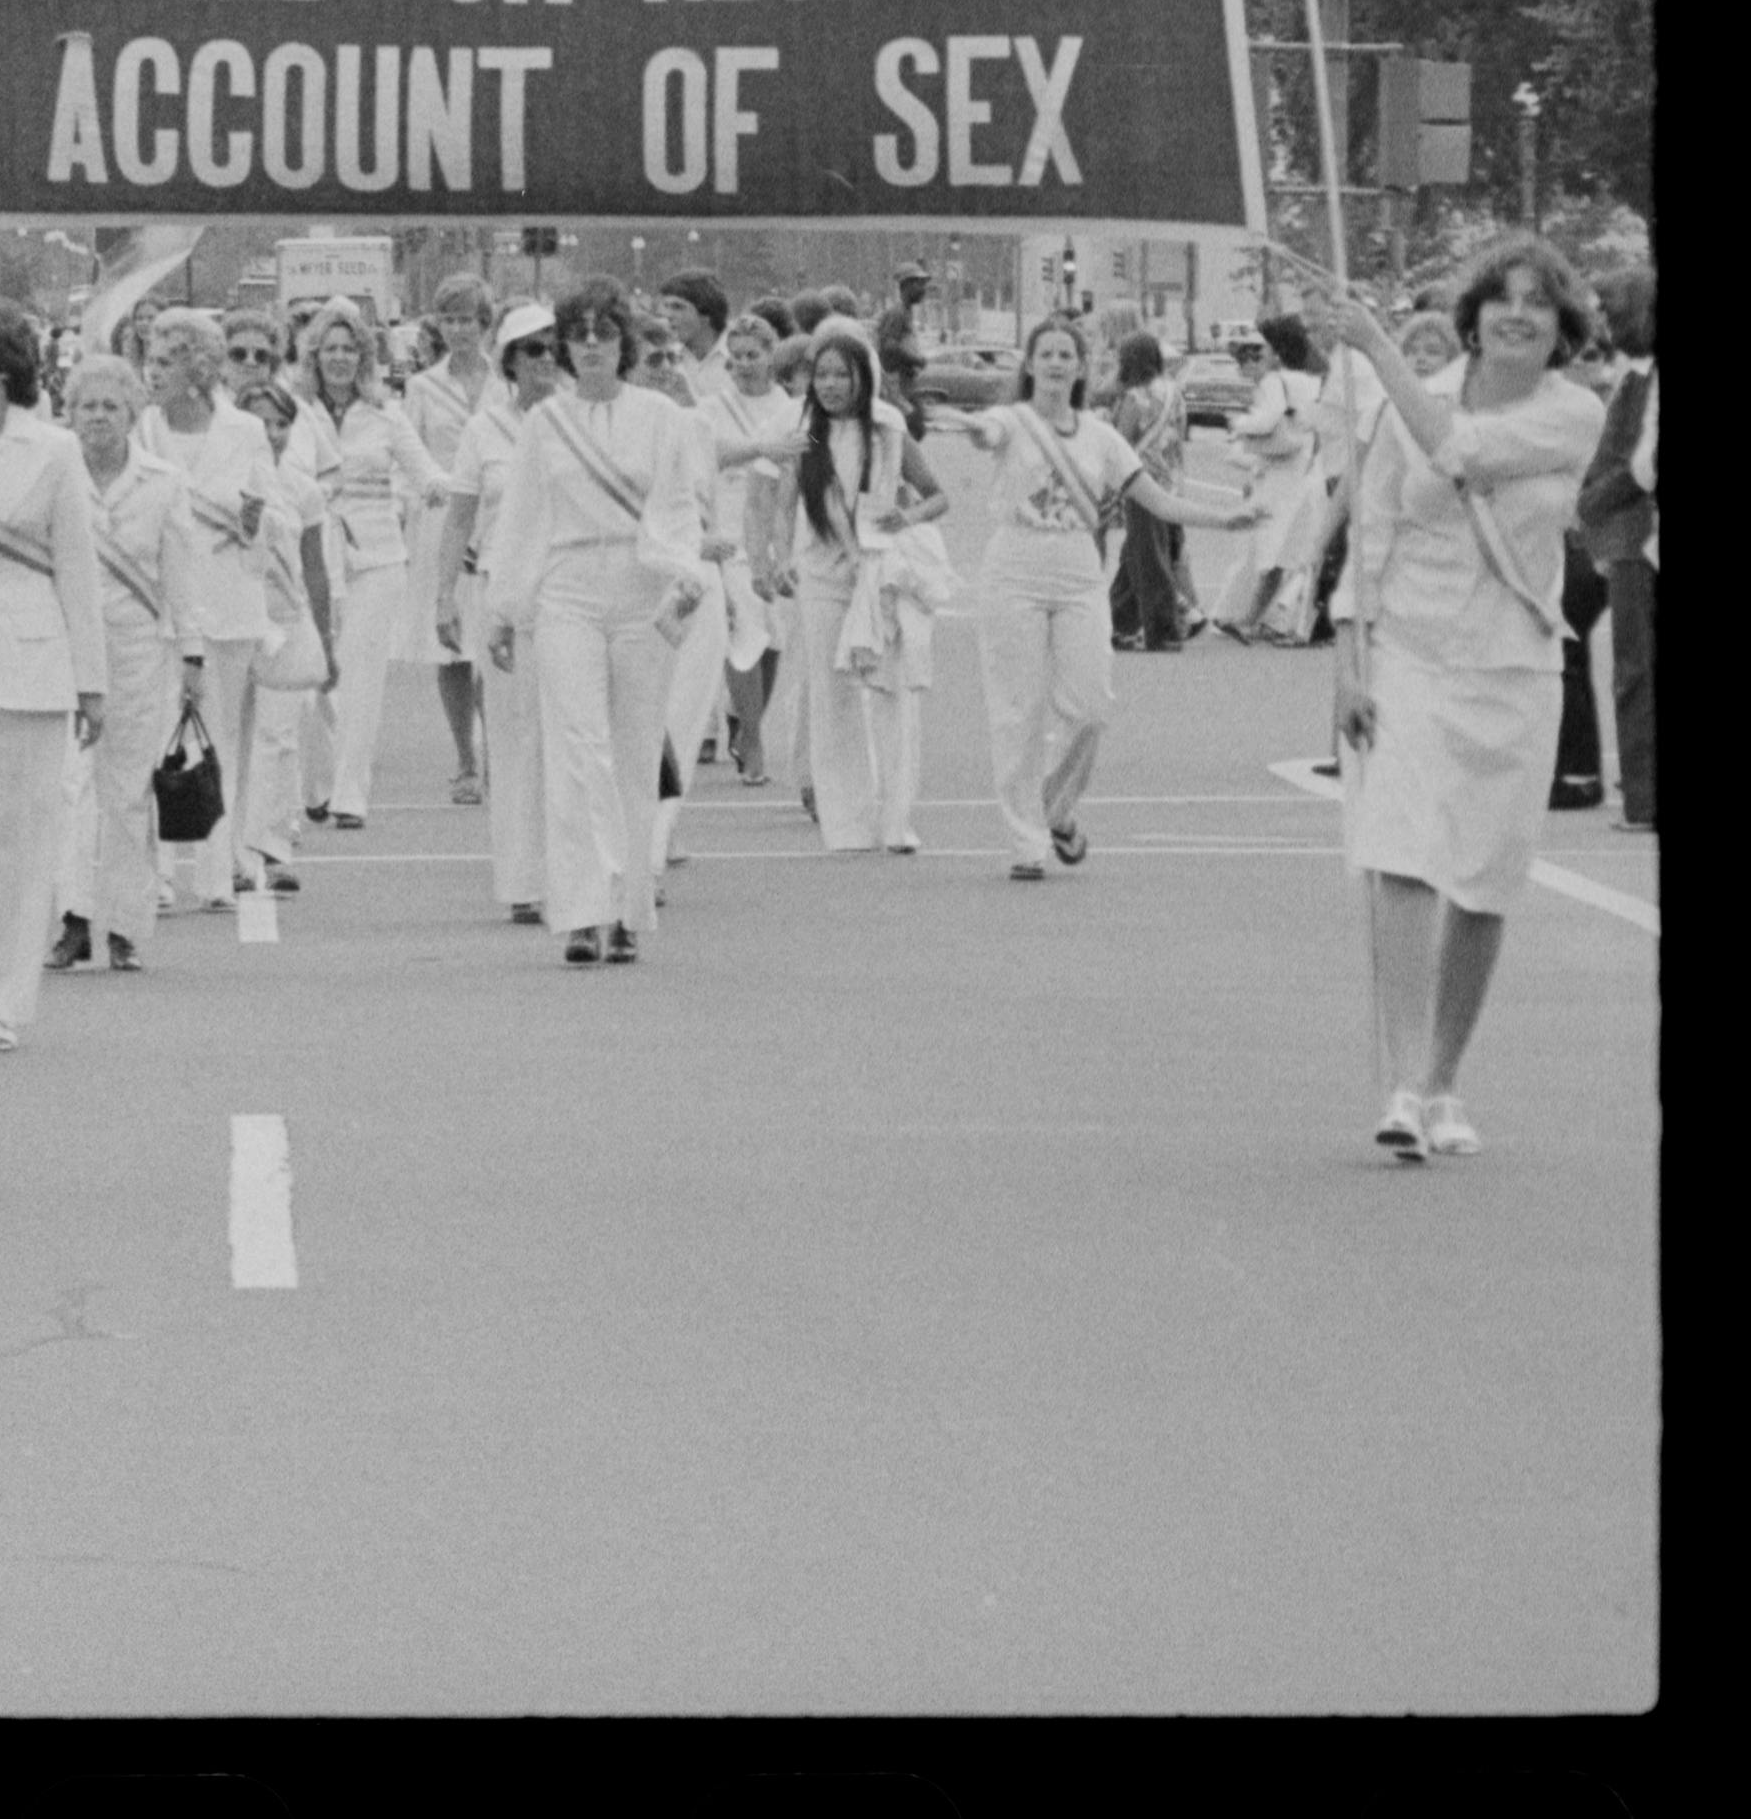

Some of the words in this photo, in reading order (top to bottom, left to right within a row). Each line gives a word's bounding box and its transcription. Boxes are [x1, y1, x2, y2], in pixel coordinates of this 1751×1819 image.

[48, 31, 552, 190] ACCOUNT
[643, 47, 779, 192] OF
[875, 35, 1083, 185] SEX
